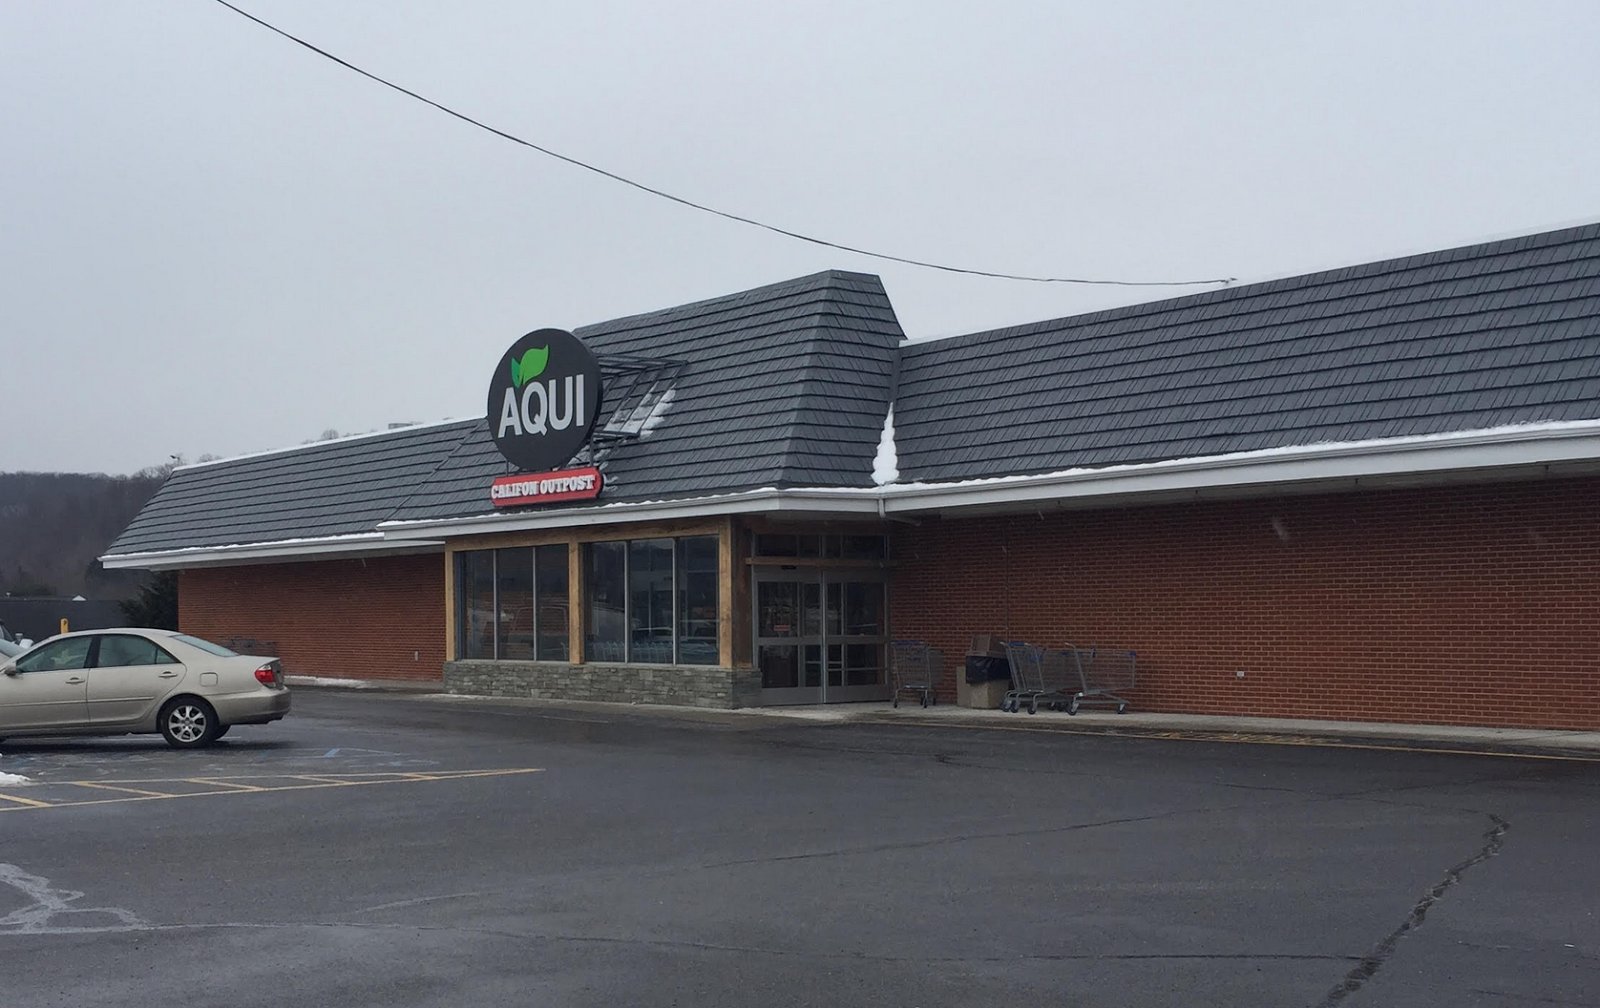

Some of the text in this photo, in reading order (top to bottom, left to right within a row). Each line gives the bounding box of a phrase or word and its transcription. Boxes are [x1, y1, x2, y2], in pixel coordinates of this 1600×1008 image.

[498, 374, 584, 438] AQUI
[491, 475, 595, 499] CALIFON OUTPOST
